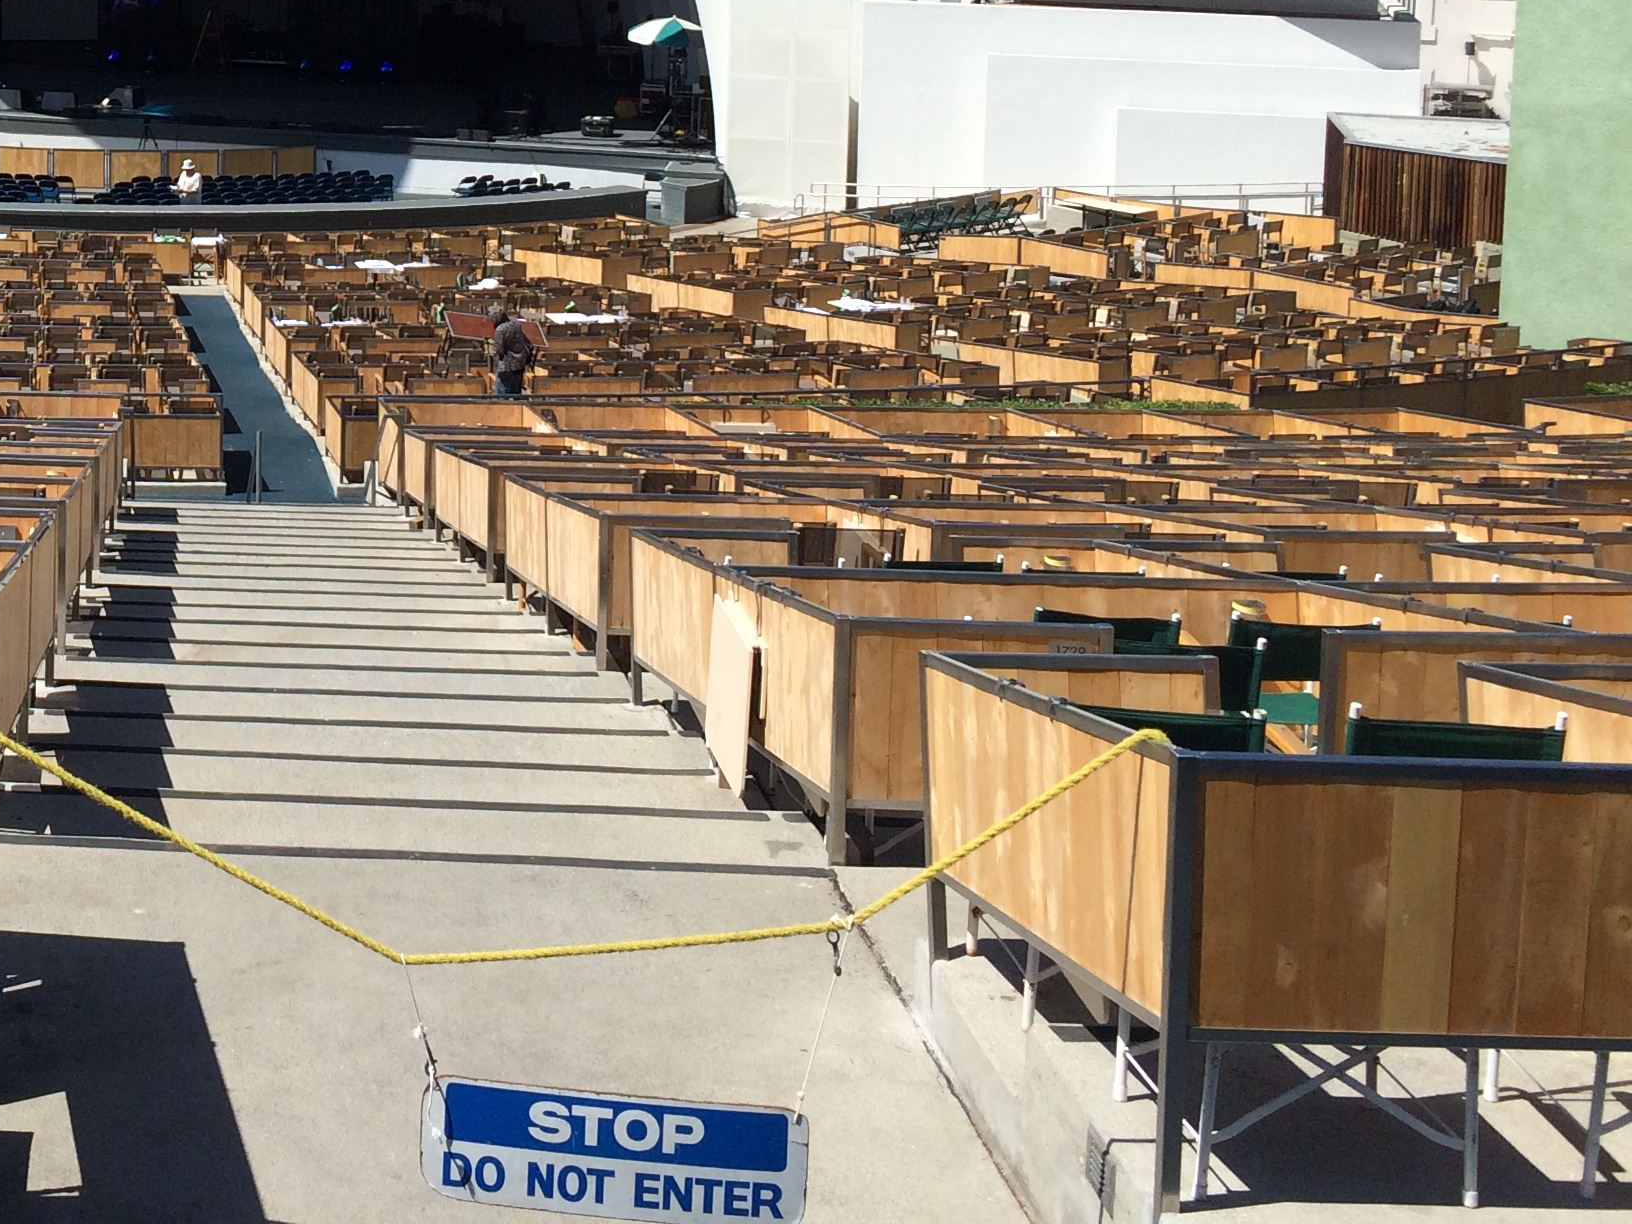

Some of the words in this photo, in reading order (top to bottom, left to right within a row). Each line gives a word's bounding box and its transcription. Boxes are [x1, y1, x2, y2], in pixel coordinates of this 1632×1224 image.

[528, 1101, 705, 1154] STOP
[442, 1151, 506, 1193] DO
[526, 1162, 615, 1204] NOT
[633, 1172, 784, 1219] ENTER
